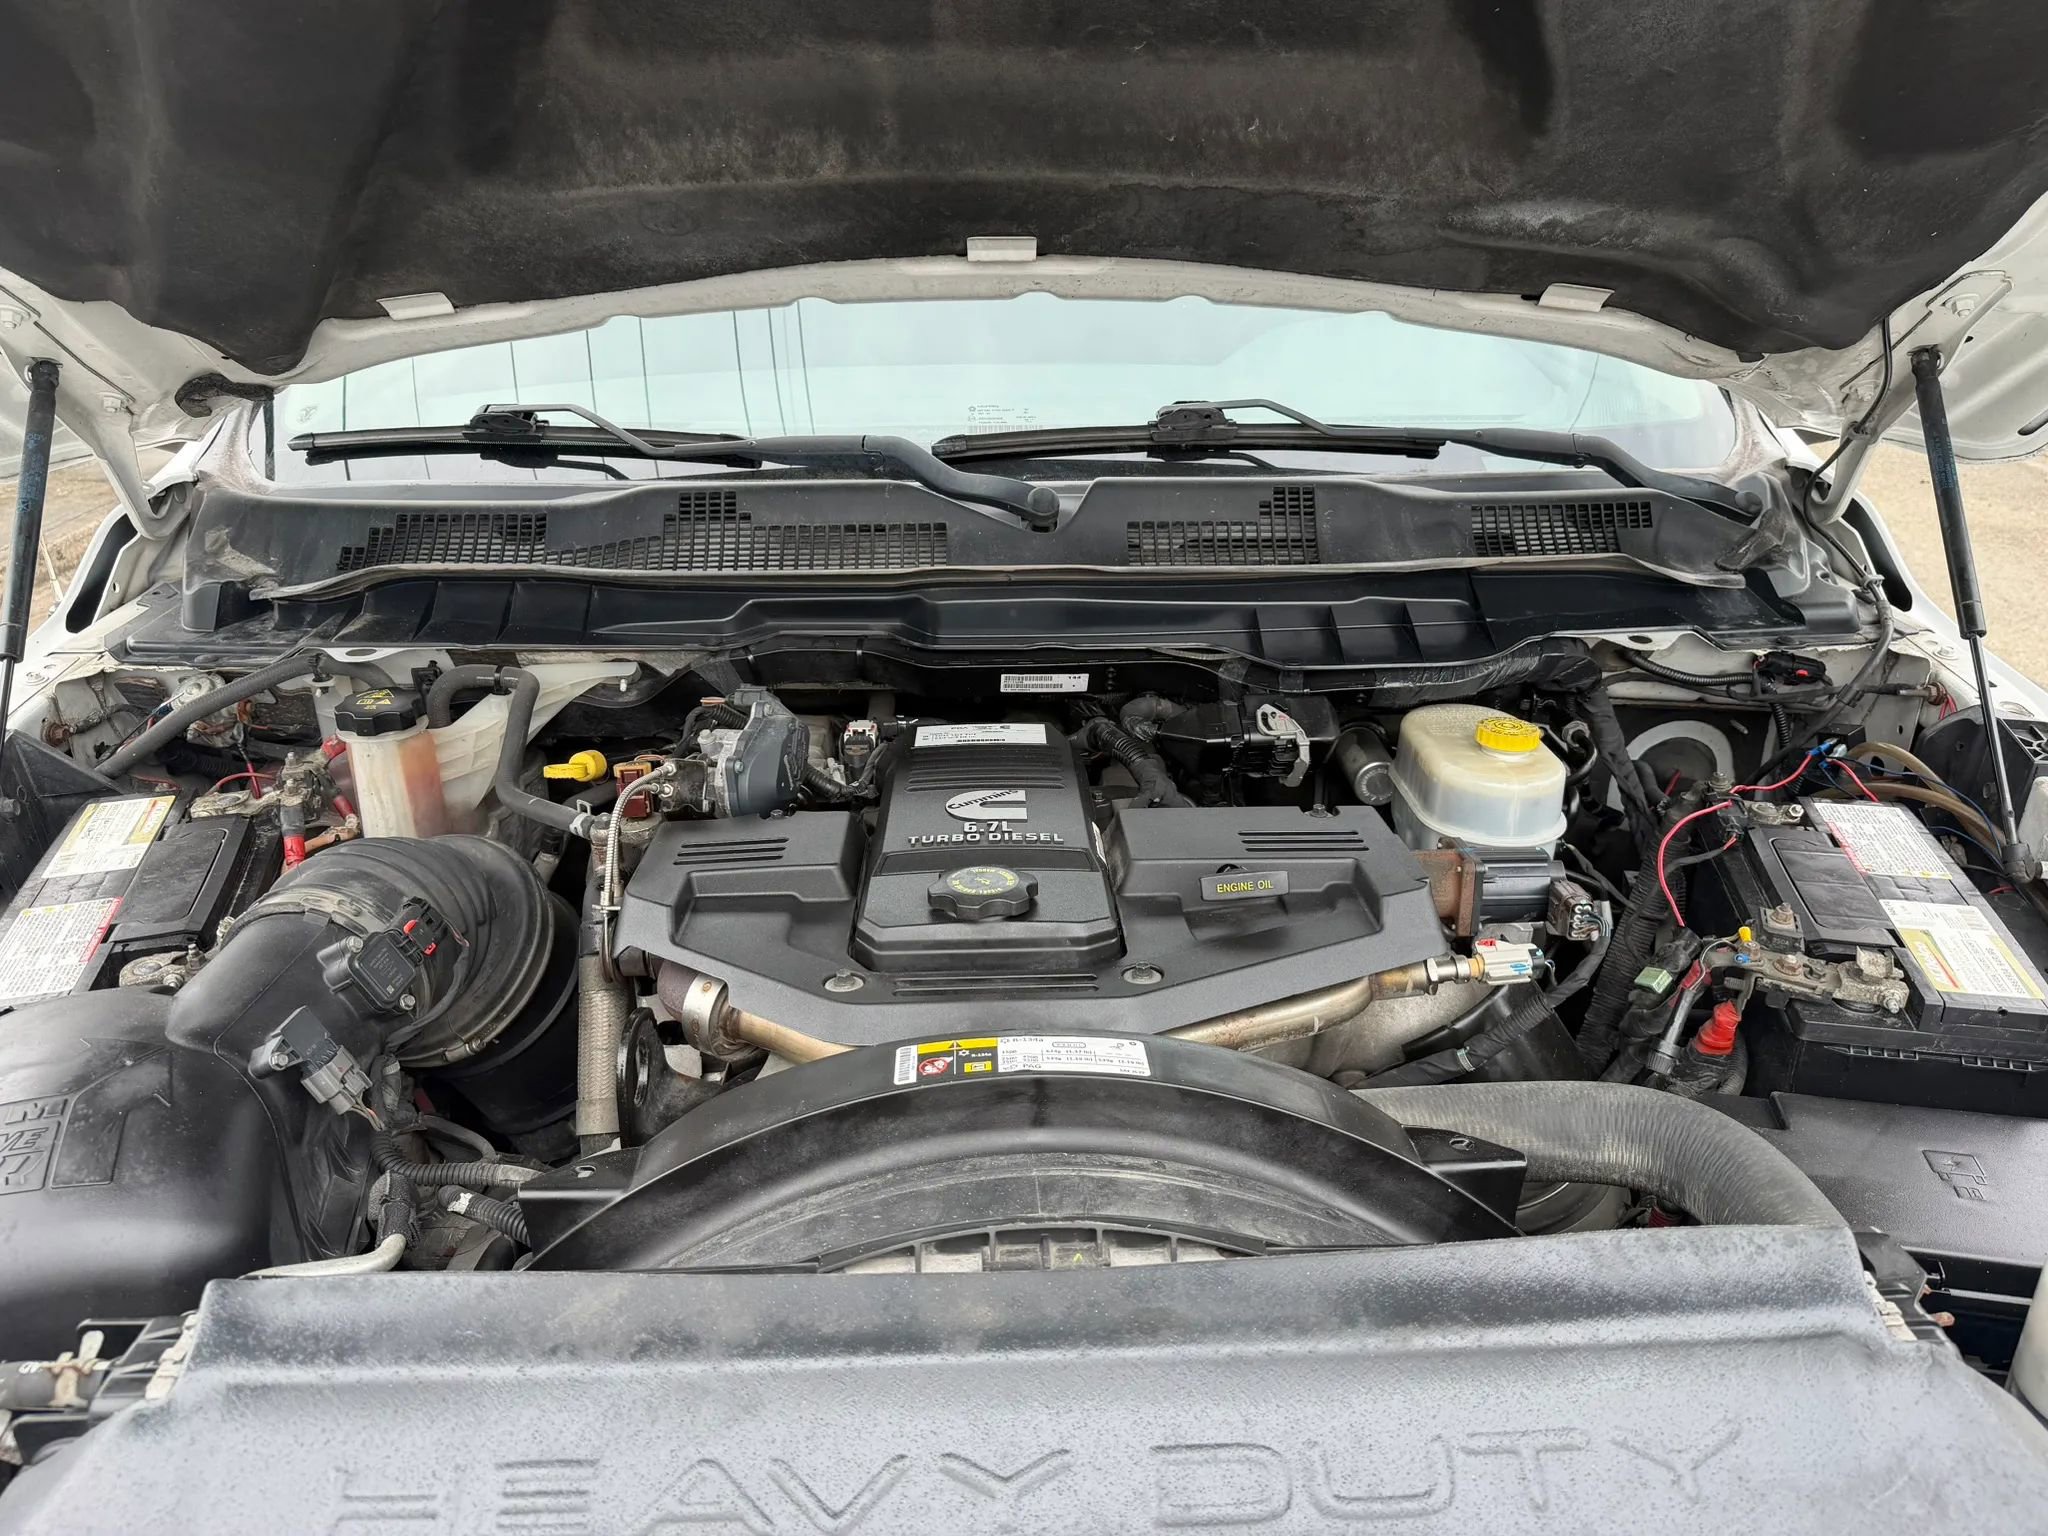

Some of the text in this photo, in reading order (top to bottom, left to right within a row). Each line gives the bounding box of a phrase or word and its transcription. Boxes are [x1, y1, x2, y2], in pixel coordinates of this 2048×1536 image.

[947, 789, 1019, 810] Cummins
[963, 821, 1014, 834] 6.7L
[908, 832, 1065, 846] TURBO DIESEL
[1216, 880, 1274, 893] ENGINE OIL
[333, 1413, 1746, 1536] HEAVY DUTY
